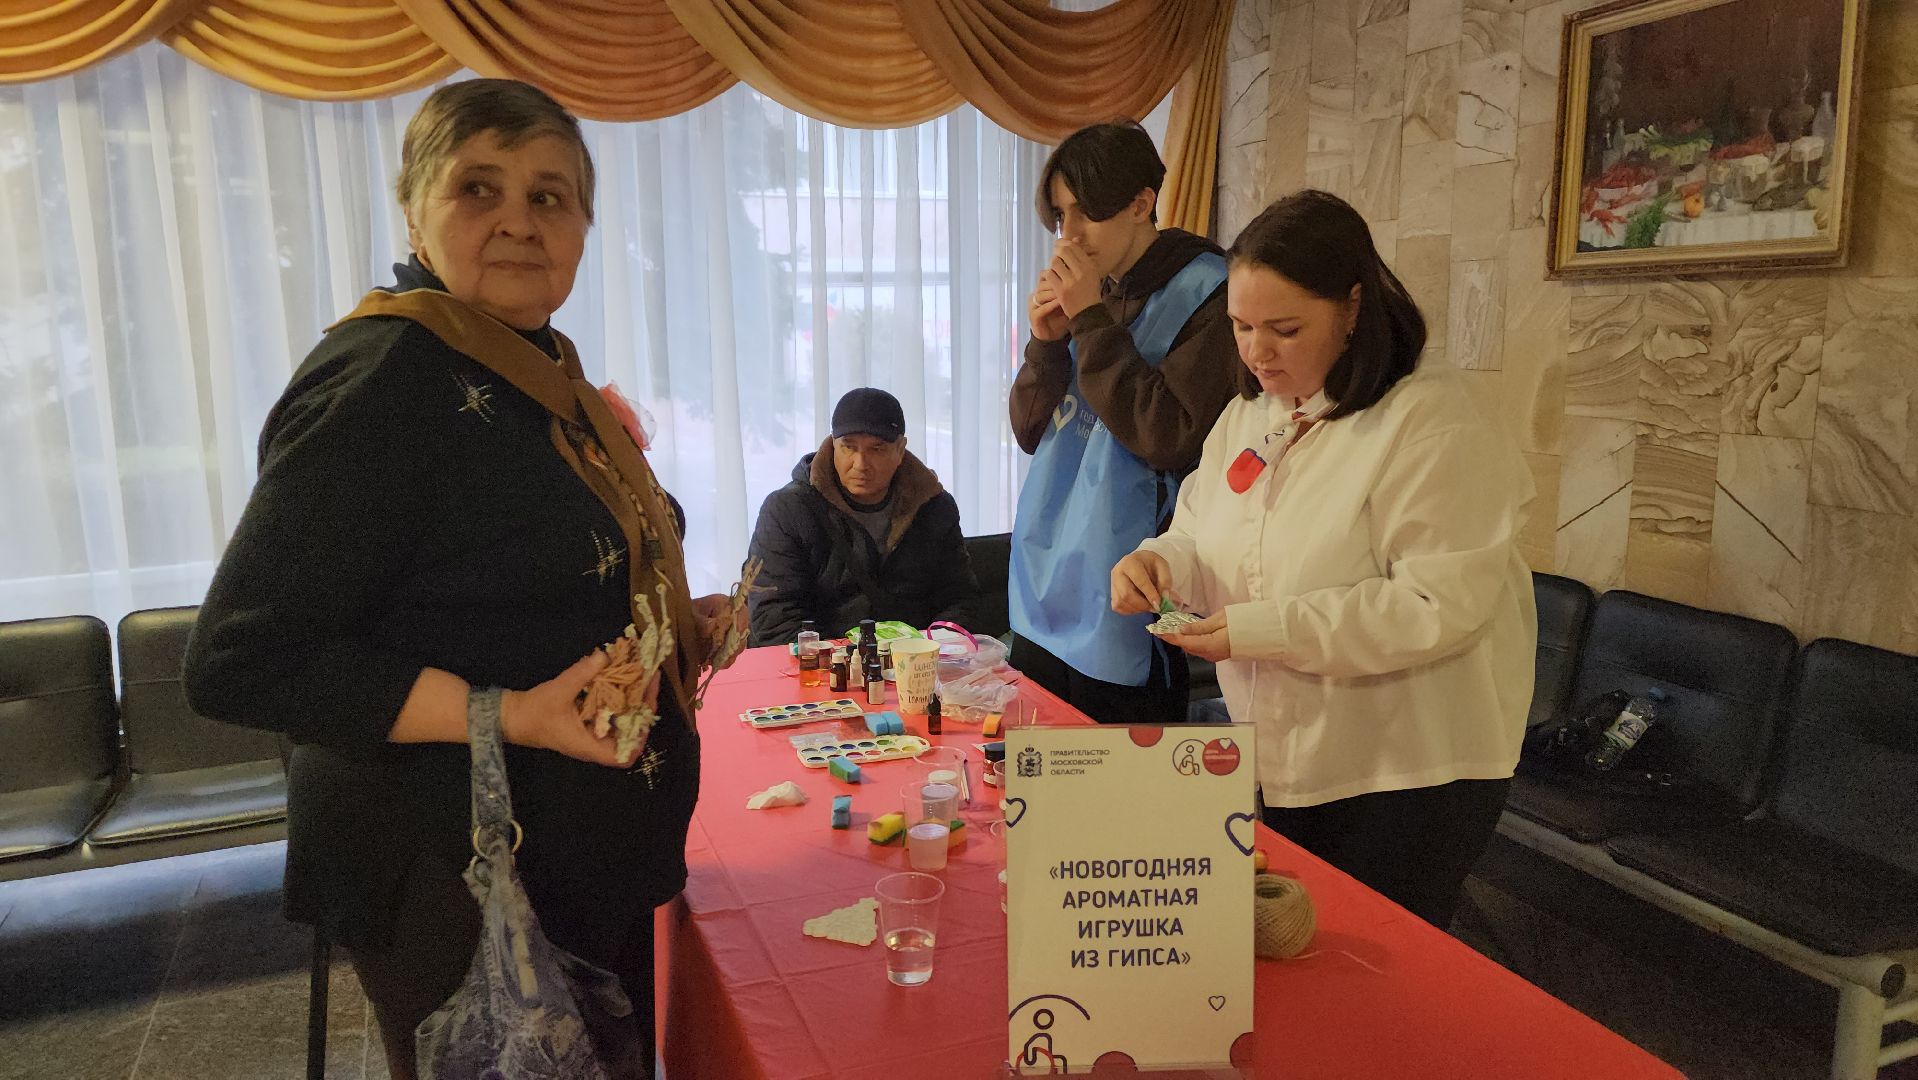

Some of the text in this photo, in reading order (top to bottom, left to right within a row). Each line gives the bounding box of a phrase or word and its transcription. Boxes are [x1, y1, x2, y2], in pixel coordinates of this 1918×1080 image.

[1049, 857, 1212, 880] «НОВОГОДНЯЯ
[1062, 887, 1198, 909] АРОМАТНАЯ
[1078, 917, 1184, 939] ИГРУШКА
[1071, 947, 1191, 968] ИЗ ГИПСА»
